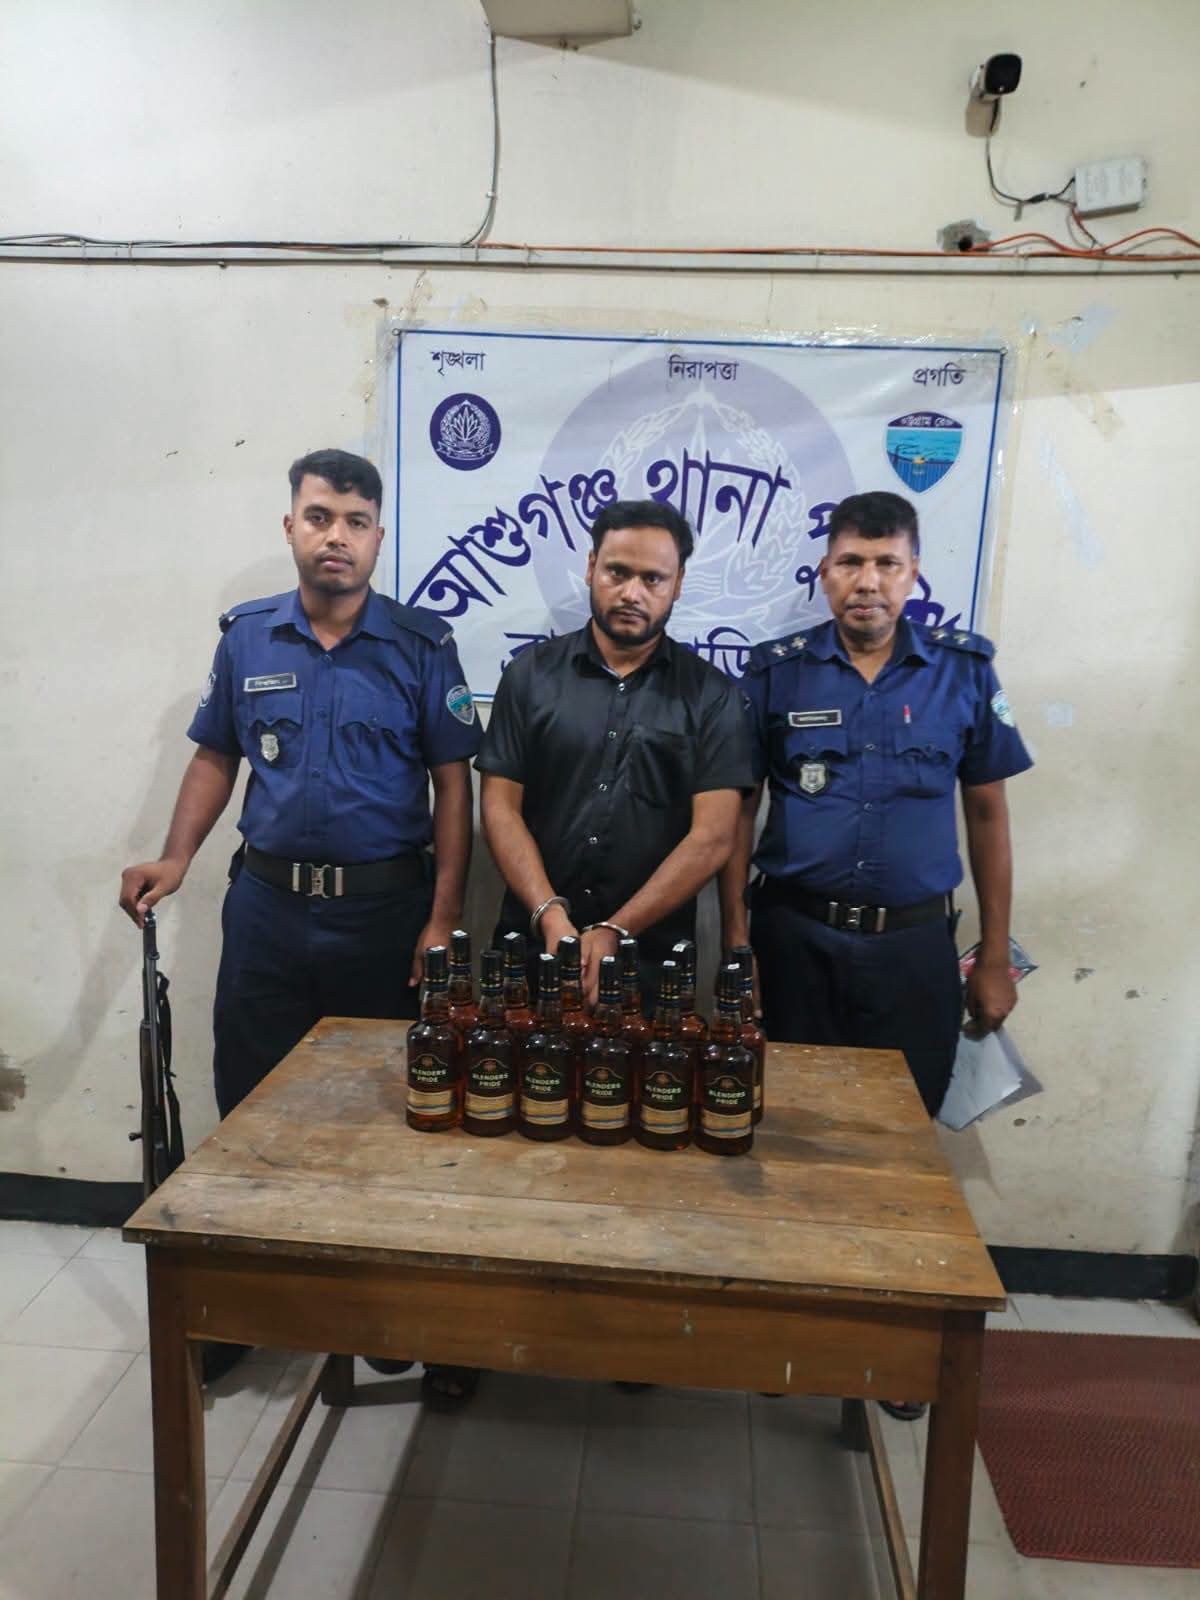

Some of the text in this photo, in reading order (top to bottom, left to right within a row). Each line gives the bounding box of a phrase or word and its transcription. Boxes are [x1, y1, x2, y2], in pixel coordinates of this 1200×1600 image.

[432, 351, 485, 375] শৃঙ্খলা
[667, 354, 738, 381] নিরাপত্তা
[912, 364, 966, 389] প্রগতি
[647, 447, 792, 548] থানা
[411, 1068, 447, 1076] BLENDERS
[472, 1073, 509, 1081] BLENDERS
[525, 1077, 561, 1085] BLENDERS
[585, 1081, 621, 1090] BLENDERS
[645, 1085, 681, 1094] BLENDERS
[708, 1090, 746, 1098] BLENDERS
[715, 1097, 738, 1105] PRIDE
